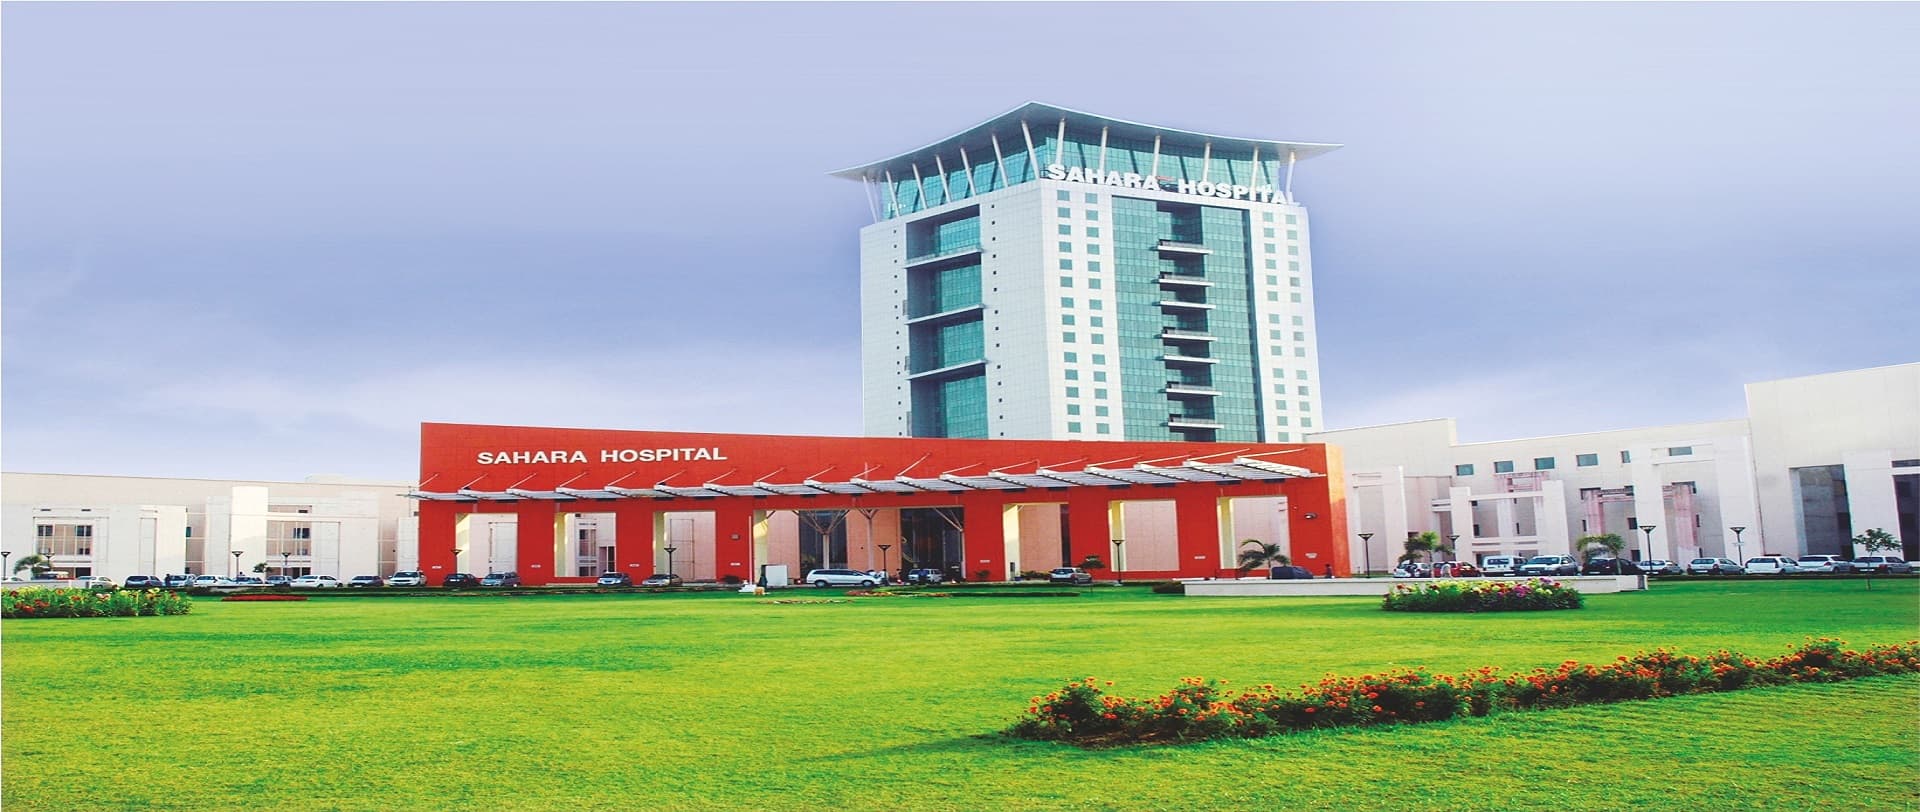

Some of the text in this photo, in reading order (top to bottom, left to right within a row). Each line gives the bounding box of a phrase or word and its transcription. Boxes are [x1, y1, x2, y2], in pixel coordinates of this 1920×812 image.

[1047, 163, 1162, 191] SAHARA
[477, 447, 727, 465] SAHARA HOSPITAL
